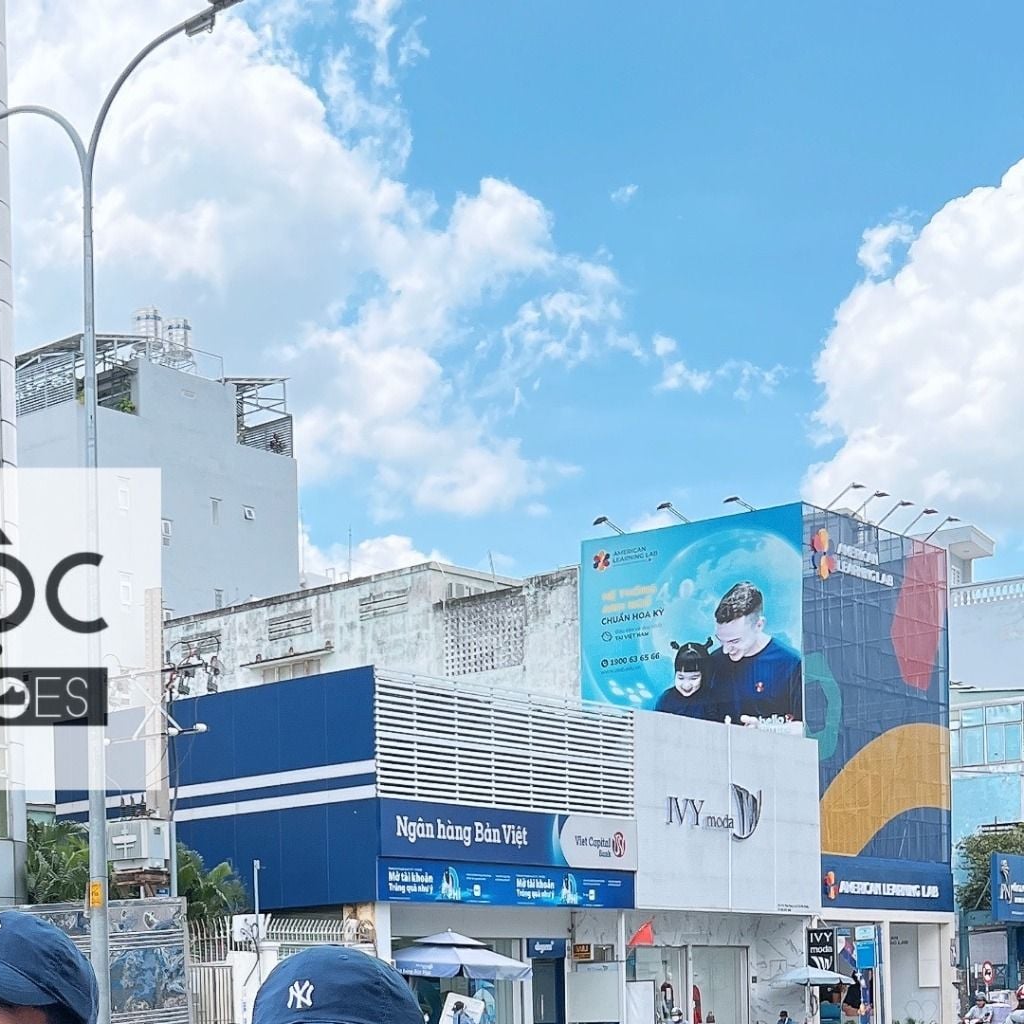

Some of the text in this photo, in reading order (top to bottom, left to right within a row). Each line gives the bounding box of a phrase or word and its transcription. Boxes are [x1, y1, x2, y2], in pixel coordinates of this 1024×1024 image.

[632, 610, 651, 621] HOA
[629, 655, 638, 663] 63
[639, 653, 650, 662] 65
[665, 796, 734, 829] IVY moda
[396, 815, 528, 849] Ngân hàng Bản Việt
[575, 835, 611, 849] Viet Capital
[838, 880, 939, 898] AMERICAN LEARNING LAB
[810, 931, 833, 943] IVY
[810, 945, 833, 954] moda
[286, 979, 315, 1009] NY
